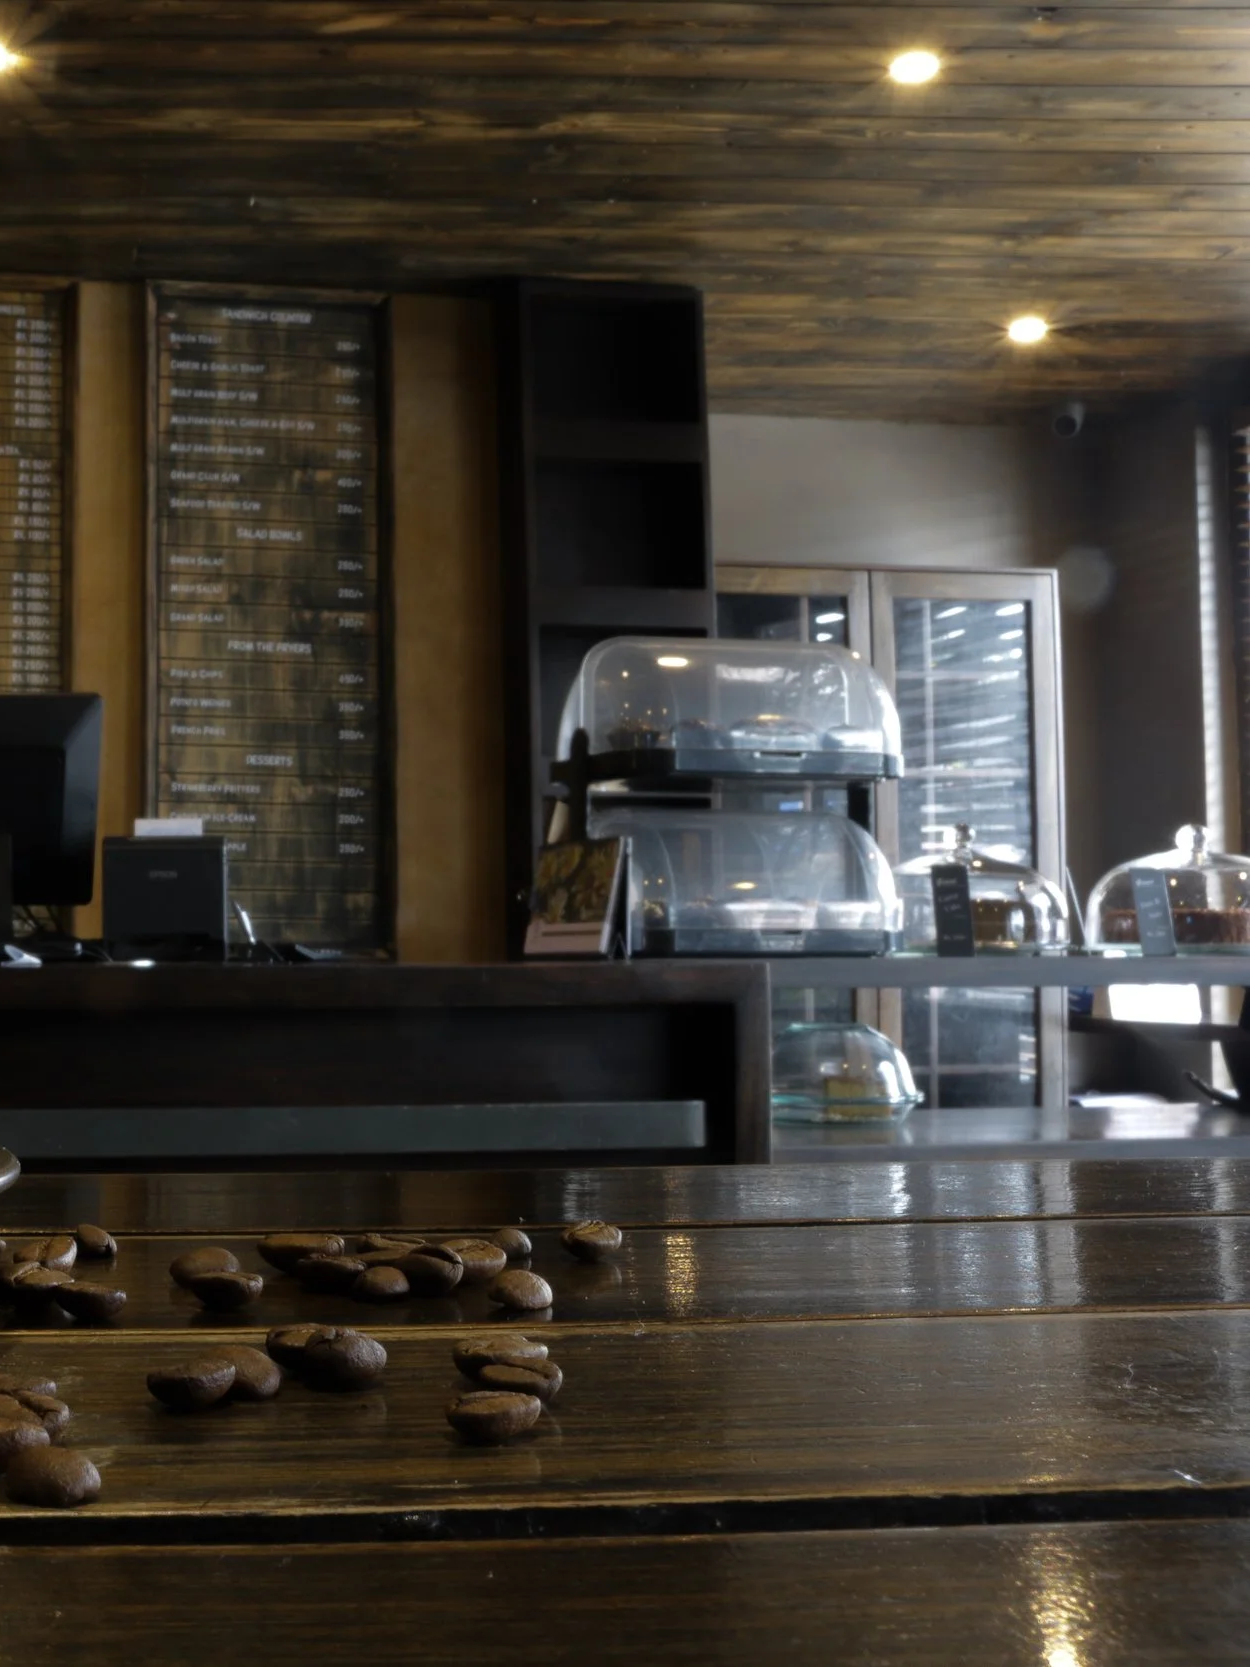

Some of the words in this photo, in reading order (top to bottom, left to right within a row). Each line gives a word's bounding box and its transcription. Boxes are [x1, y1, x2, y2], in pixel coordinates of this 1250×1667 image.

[222, 309, 267, 321] SANDWICH
[270, 311, 313, 324] COUNTER
[236, 528, 267, 539] SALAD
[269, 528, 302, 541] BOWLS
[228, 640, 254, 650] FROM
[256, 642, 275, 652] THE
[276, 642, 312, 654] FRYERS
[199, 670, 223, 679] CHIPS
[203, 726, 226, 736] FRIES
[246, 754, 293, 767] DESSERTS
[171, 782, 222, 793] STRAWBERRY
